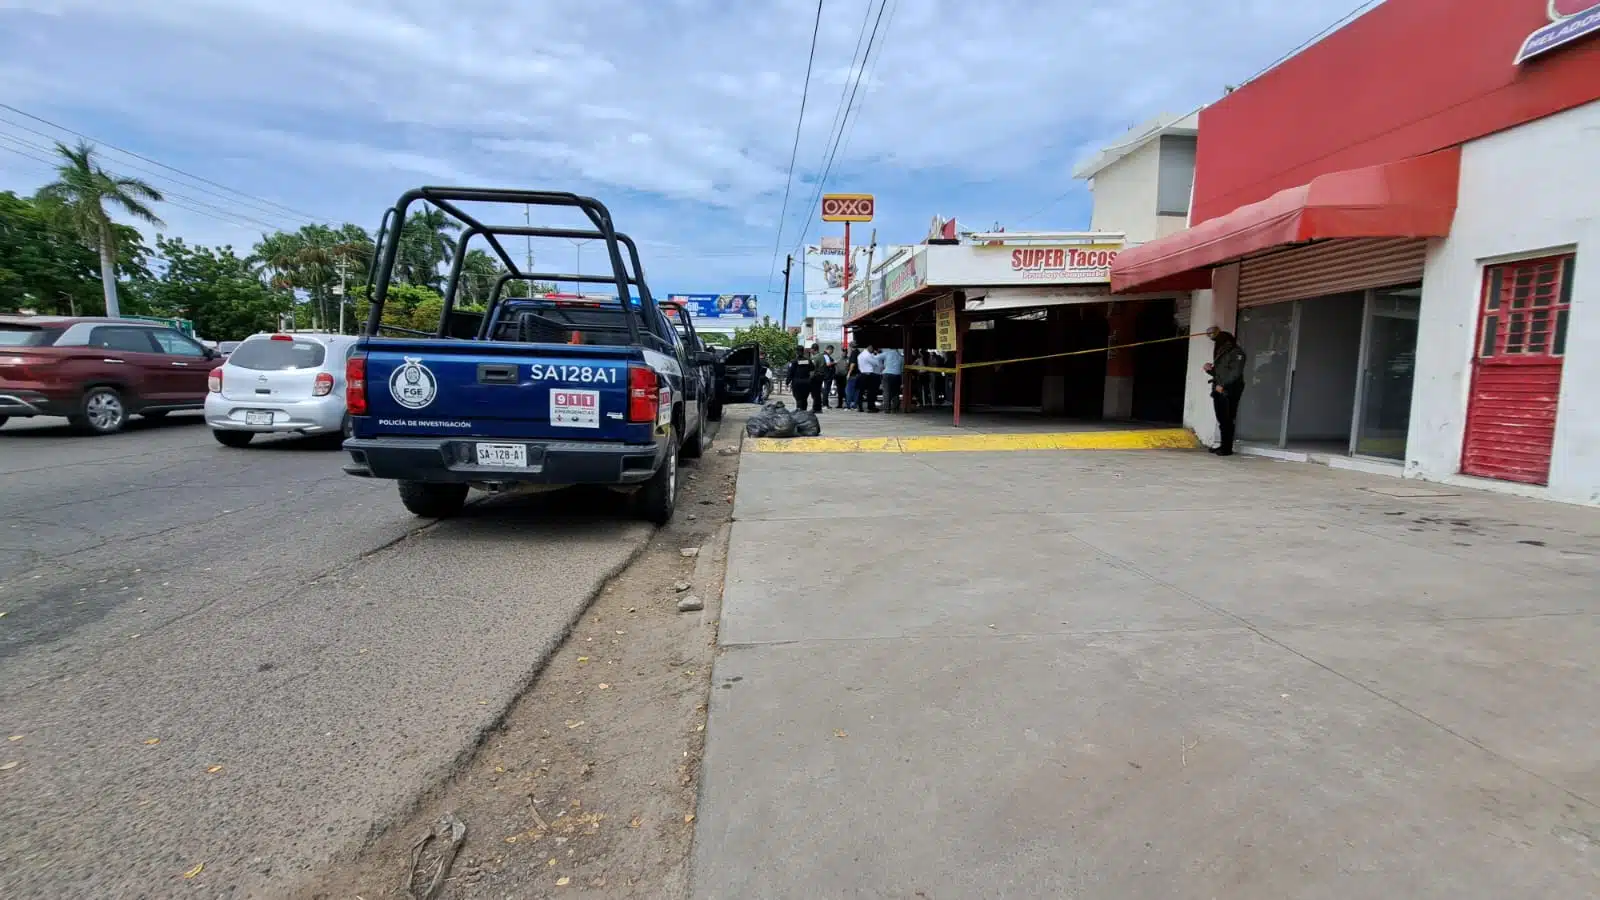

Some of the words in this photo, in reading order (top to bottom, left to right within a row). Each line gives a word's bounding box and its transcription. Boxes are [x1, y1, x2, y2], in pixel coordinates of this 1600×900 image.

[824, 198, 873, 216] OXXO
[1012, 248, 1065, 271] SUPER
[531, 364, 617, 384] SA128A1
[403, 388, 423, 396] FGE
[556, 394, 593, 406] 911
[378, 419, 407, 427] POLICÍA
[418, 420, 472, 429] INVESTIGACIÓN
